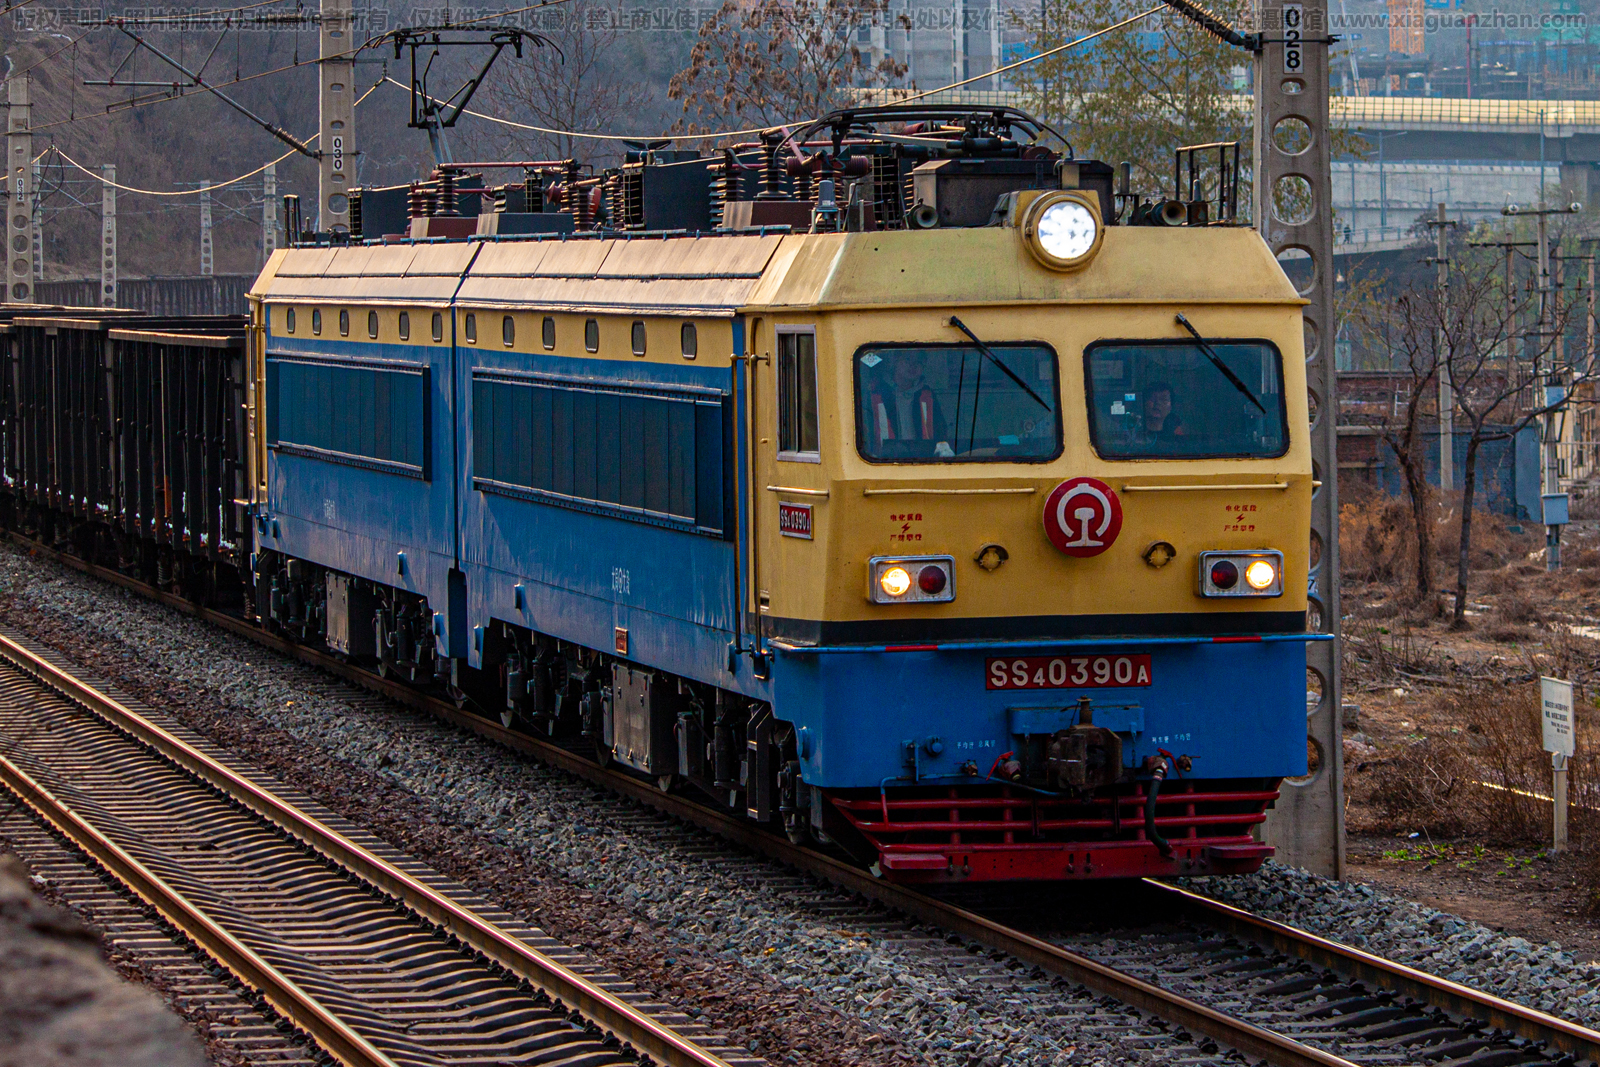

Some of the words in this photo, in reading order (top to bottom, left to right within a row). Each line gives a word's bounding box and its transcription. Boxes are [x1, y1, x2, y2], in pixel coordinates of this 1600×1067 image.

[1286, 8, 1301, 69] 028
[334, 138, 342, 169] 030
[991, 657, 1149, 687] SS40390A
